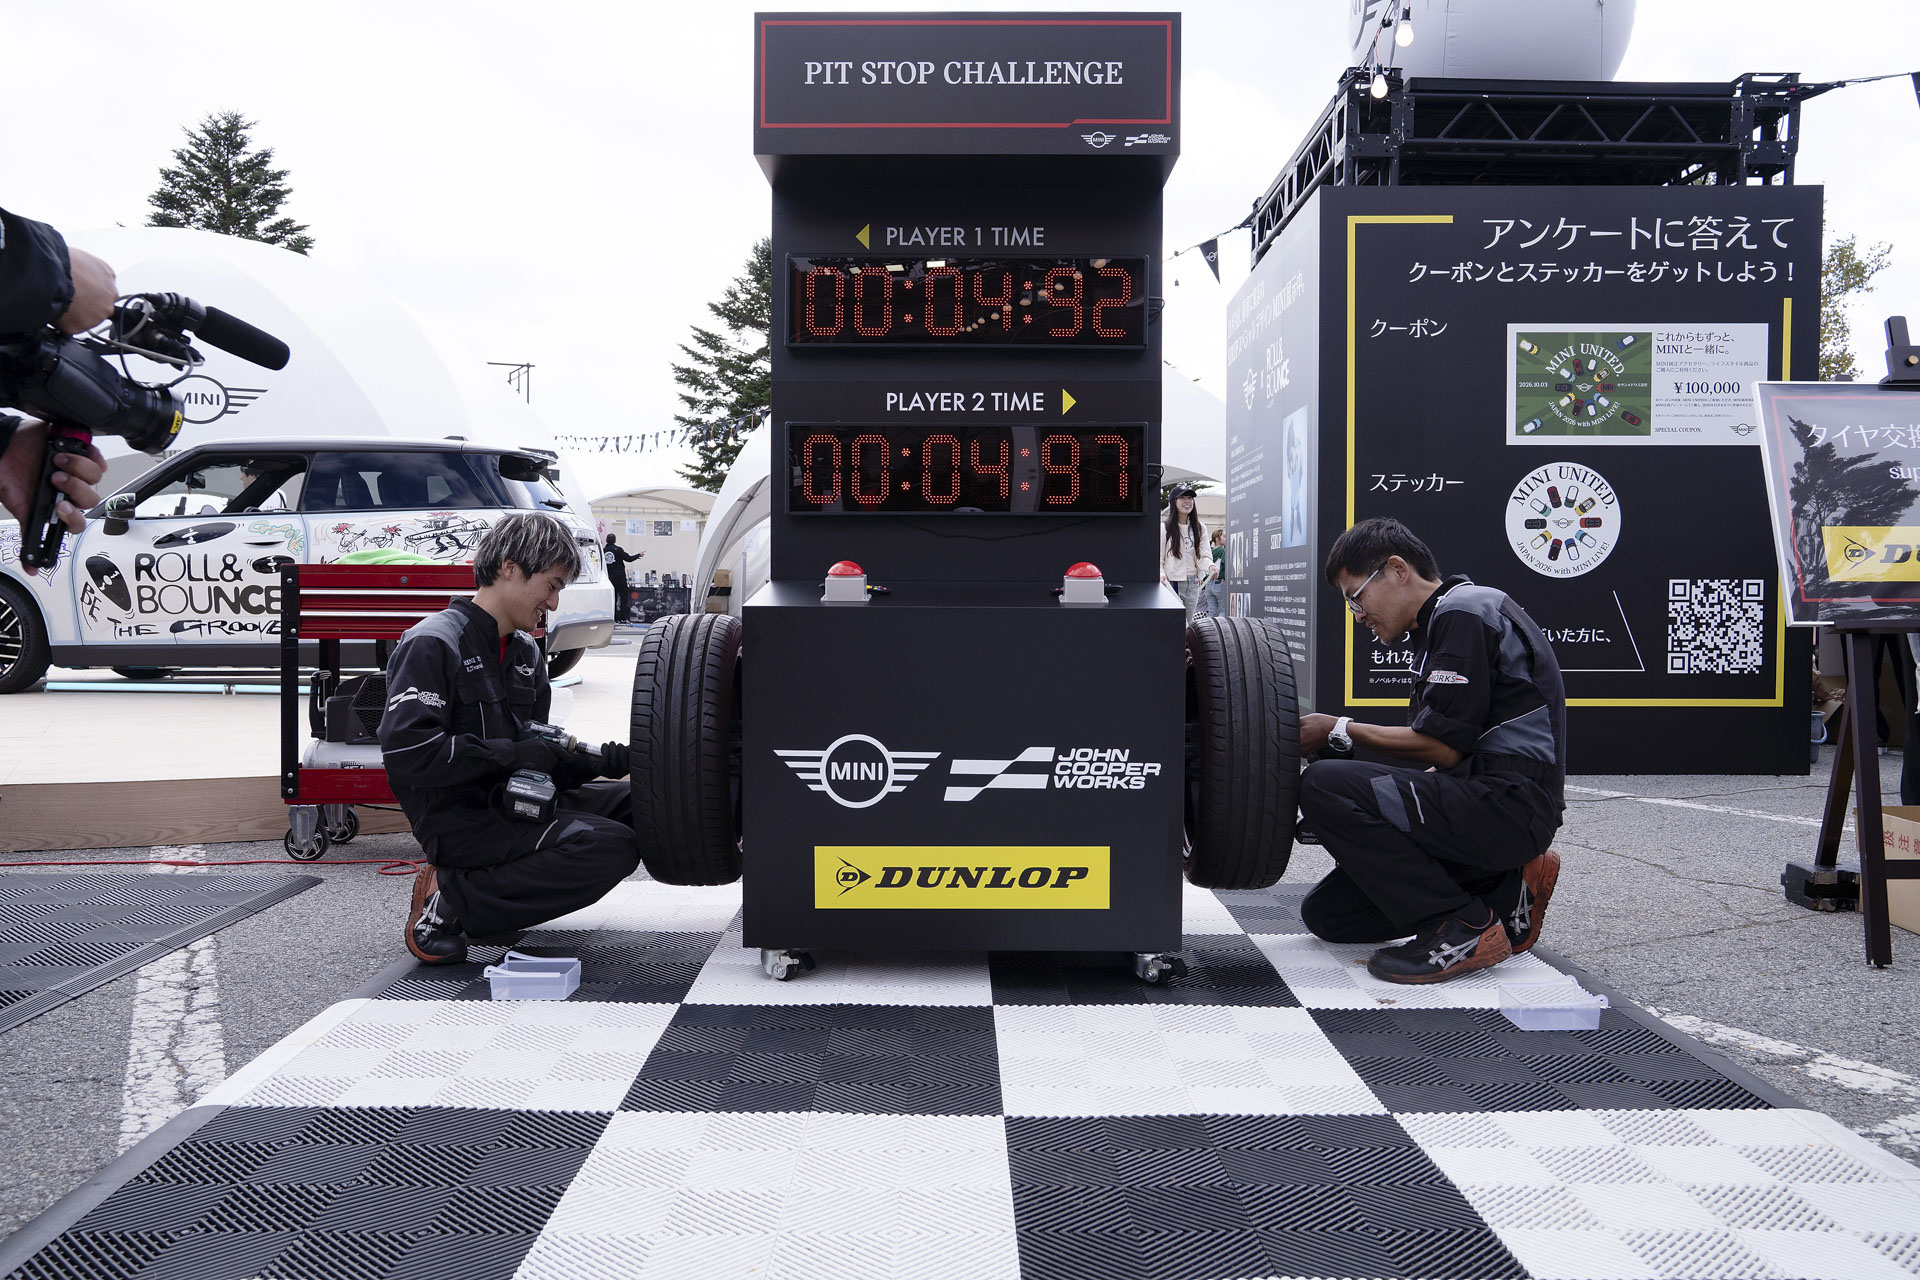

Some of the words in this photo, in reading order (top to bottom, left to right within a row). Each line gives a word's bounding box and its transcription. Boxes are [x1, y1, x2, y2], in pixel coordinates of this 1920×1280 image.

[805, 62, 852, 85] PIT
[862, 61, 935, 85] STOP
[944, 61, 1123, 85] CHALLENGE
[886, 227, 965, 246] PLAYER
[974, 227, 982, 246] 1
[991, 227, 1044, 246] TIME
[1483, 215, 1794, 251] アンケートに答えて
[805, 266, 1132, 338] 00:04:92
[1370, 319, 1448, 338] クーポン
[1656, 332, 1735, 342] これからもずっと、
[1545, 345, 1576, 375] MINI
[1656, 344, 1730, 355] MINIと一緒に。
[886, 392, 966, 411] PLAYER
[971, 392, 985, 411] 2
[991, 392, 1044, 411] TIME
[1548, 401, 1564, 421] JAPAN
[1562, 416, 1577, 427] 2026
[1591, 415, 1607, 427] MINI
[1605, 401, 1621, 420] LIVE!
[803, 433, 1129, 505] 00:04:97
[1370, 473, 1465, 492] ステッカー
[1512, 469, 1552, 506] MINI
[1516, 541, 1536, 563] JAPAN
[1534, 560, 1553, 573] 2026
[1572, 560, 1593, 573] MINI
[1592, 541, 1611, 562] LIVE!
[1880, 544, 1920, 564] D
[134, 552, 244, 583] ROLL&
[136, 584, 282, 615] BOUNCE
[1058, 748, 1130, 762] JOHN
[831, 761, 883, 781] MINI
[1055, 762, 1162, 776] COOPER
[1053, 775, 1146, 790] WORKS
[874, 866, 1089, 889] DUNLOP
